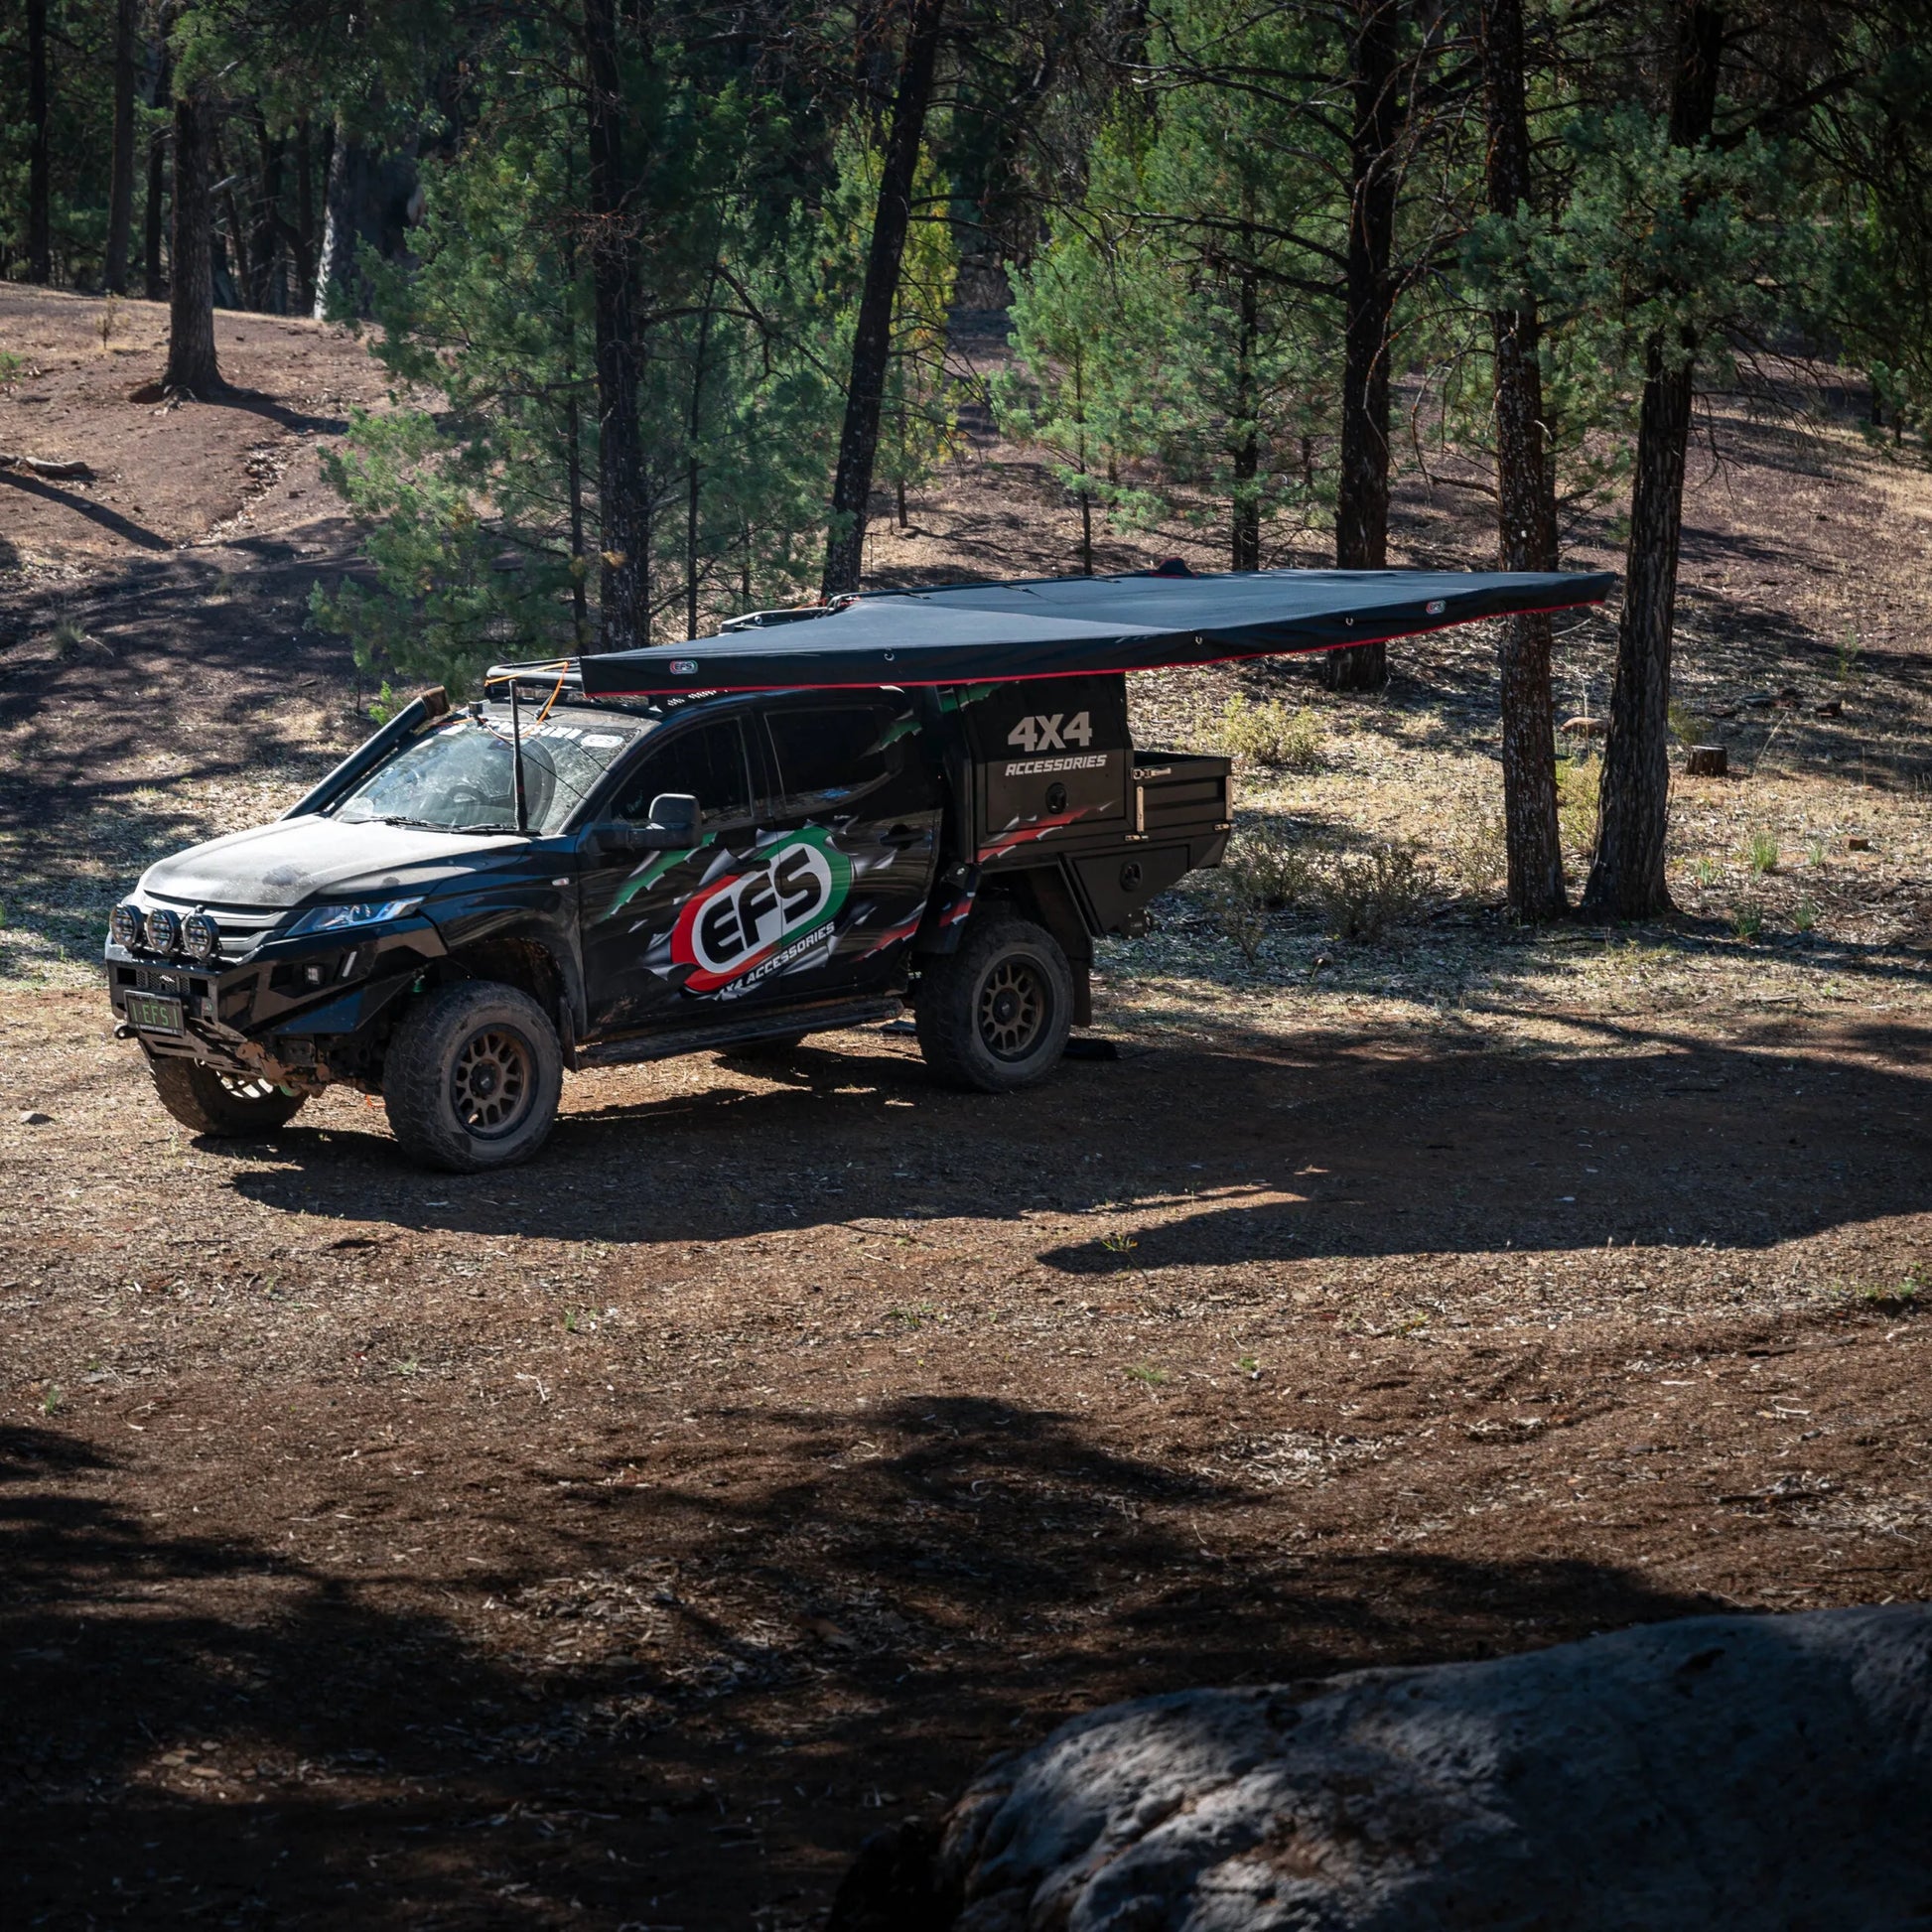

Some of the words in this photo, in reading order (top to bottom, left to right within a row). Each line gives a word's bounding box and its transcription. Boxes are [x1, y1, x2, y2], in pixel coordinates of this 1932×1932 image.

[674, 662, 694, 671] EFS
[1008, 711, 1092, 752] 4X4
[1005, 755, 1107, 776] ACCESSORIES
[701, 847, 822, 964] EFS
[746, 921, 836, 984] ACCESSORIES
